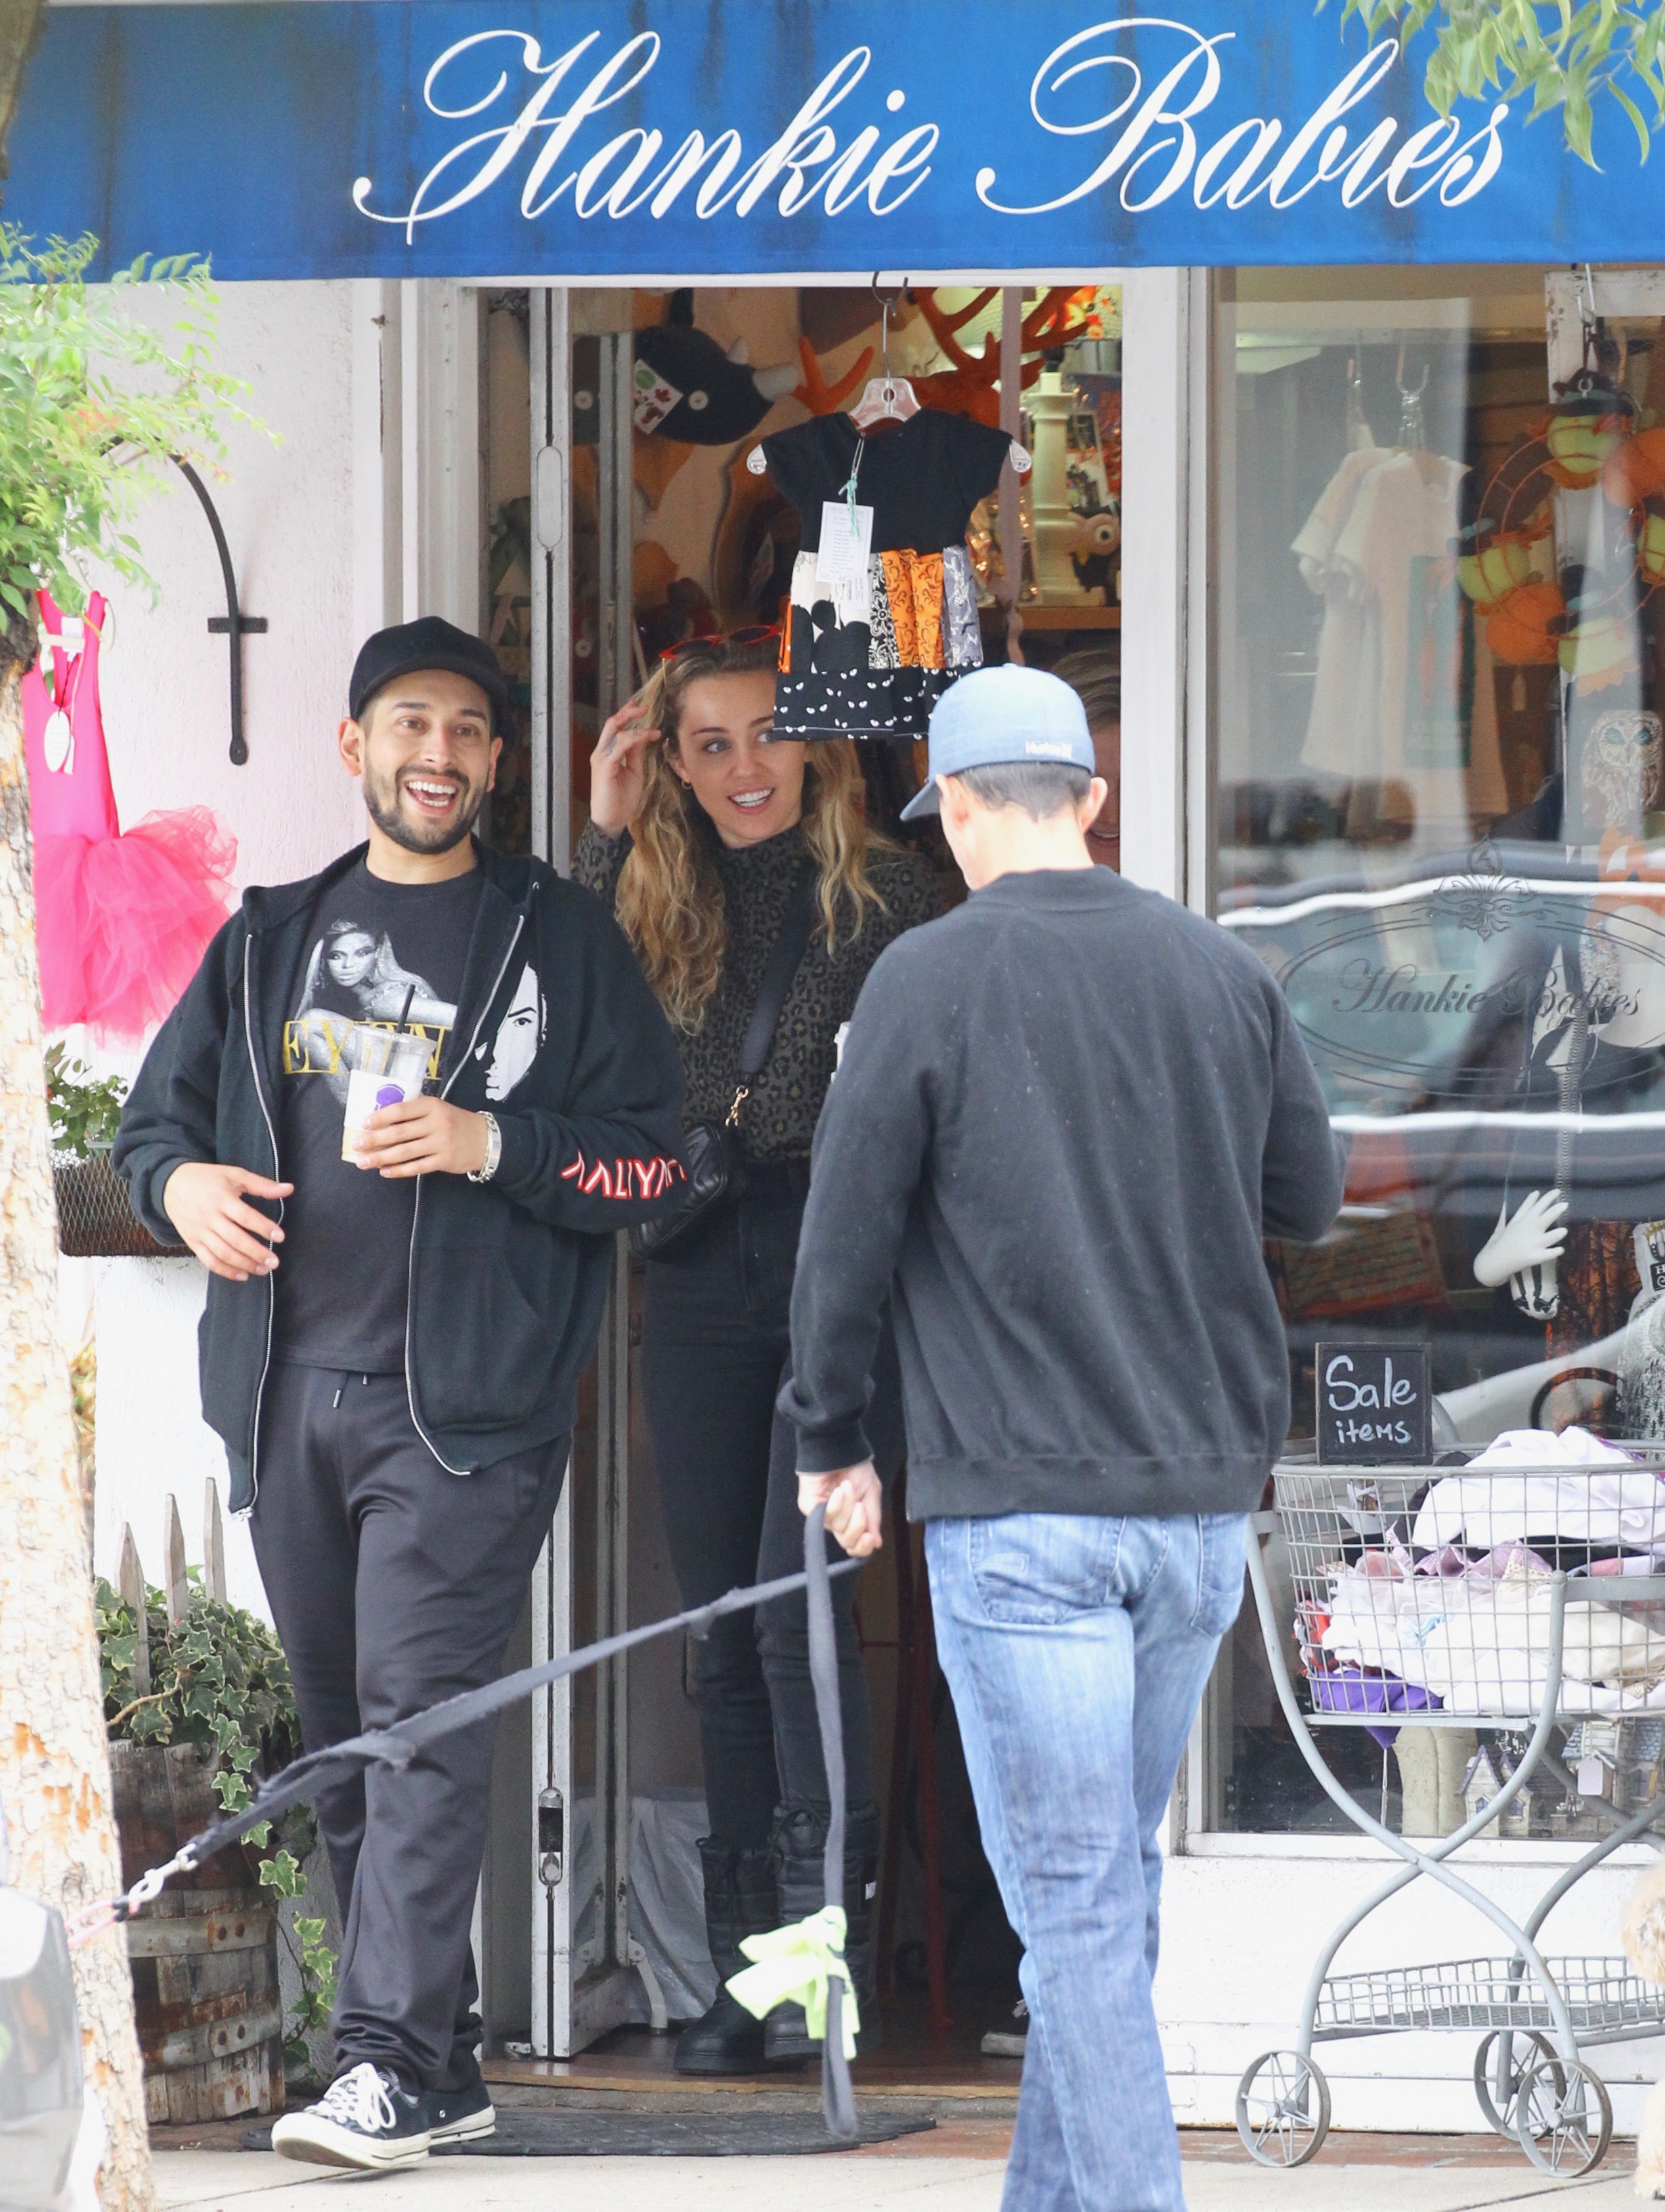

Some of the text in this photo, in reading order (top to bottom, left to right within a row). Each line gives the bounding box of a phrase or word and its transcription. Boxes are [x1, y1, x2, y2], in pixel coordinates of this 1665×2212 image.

[353, 18, 1509, 245] Hankie Babies
[1332, 958, 1641, 1017] Hankie Babies
[1326, 1355, 1417, 1411] Sale
[1335, 1419, 1412, 1444] items
